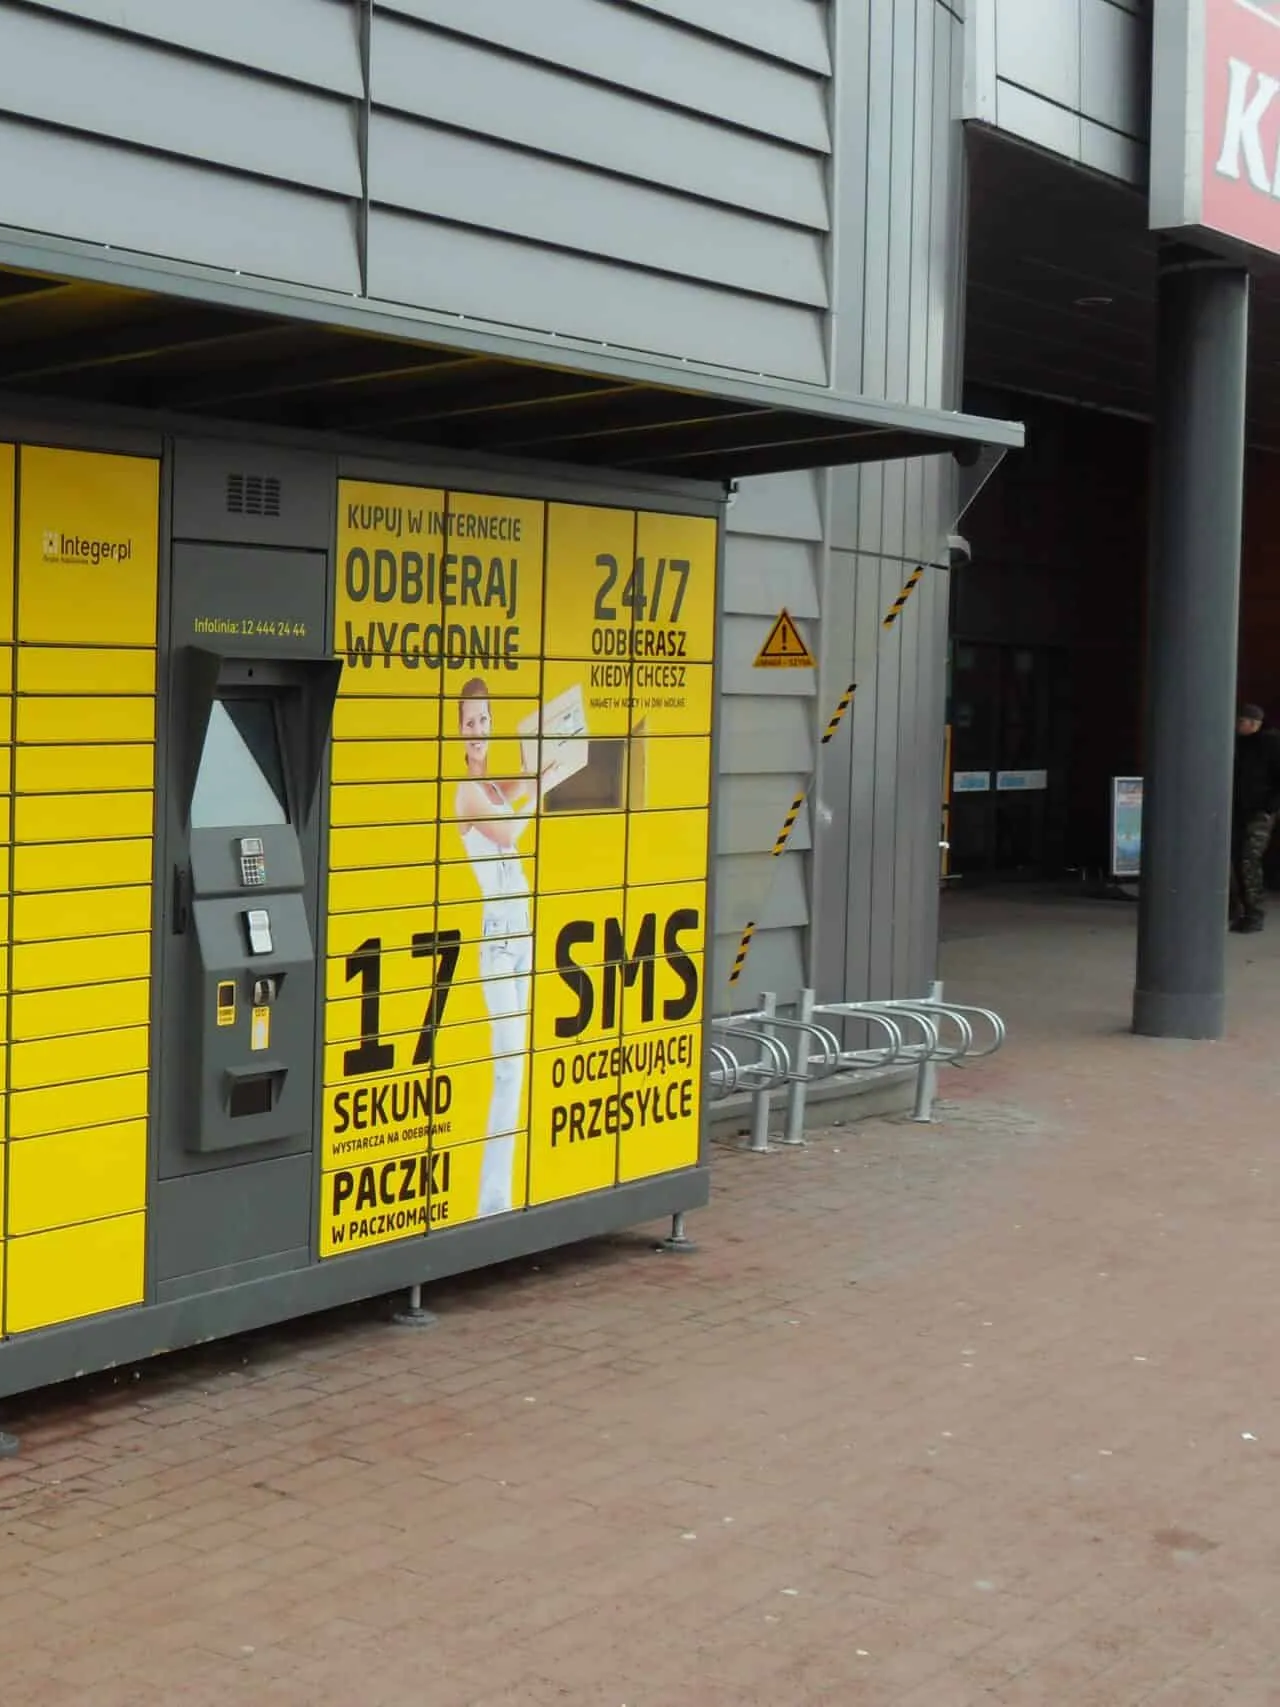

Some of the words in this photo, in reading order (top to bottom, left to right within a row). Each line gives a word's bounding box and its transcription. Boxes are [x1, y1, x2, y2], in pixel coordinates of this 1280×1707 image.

[1216, 57, 1280, 200] K
[348, 504, 402, 537] KUPUJ
[408, 510, 423, 533] W
[428, 512, 521, 541] INTERNECIE
[346, 547, 518, 620] ODBIERAJ
[594, 553, 690, 623] 24/7
[194, 618, 239, 633] Infolinia:
[242, 620, 253, 634] 12
[256, 621, 275, 635] 444
[279, 622, 290, 636] 24
[293, 623, 305, 636] 44
[345, 620, 519, 670] WYGODNIE
[592, 628, 686, 657] ODBIERASZ
[591, 664, 631, 687] KIEDY
[637, 665, 686, 687] CHCESZ
[555, 908, 699, 1039] SMS
[344, 929, 461, 1076] 17
[552, 1057, 565, 1088] O
[572, 1034, 693, 1084] OCZEKUJĄCEJ
[334, 1074, 452, 1134] SEKUND
[551, 1079, 692, 1147] PRZESYŁCE
[332, 1134, 385, 1156] WYSTARCZA
[387, 1130, 399, 1144] NA
[402, 1122, 451, 1141] ODEBRANIE
[333, 1152, 450, 1216] PACZKI
[331, 1224, 345, 1245] W
[349, 1201, 449, 1241] PACZKOMACIE
